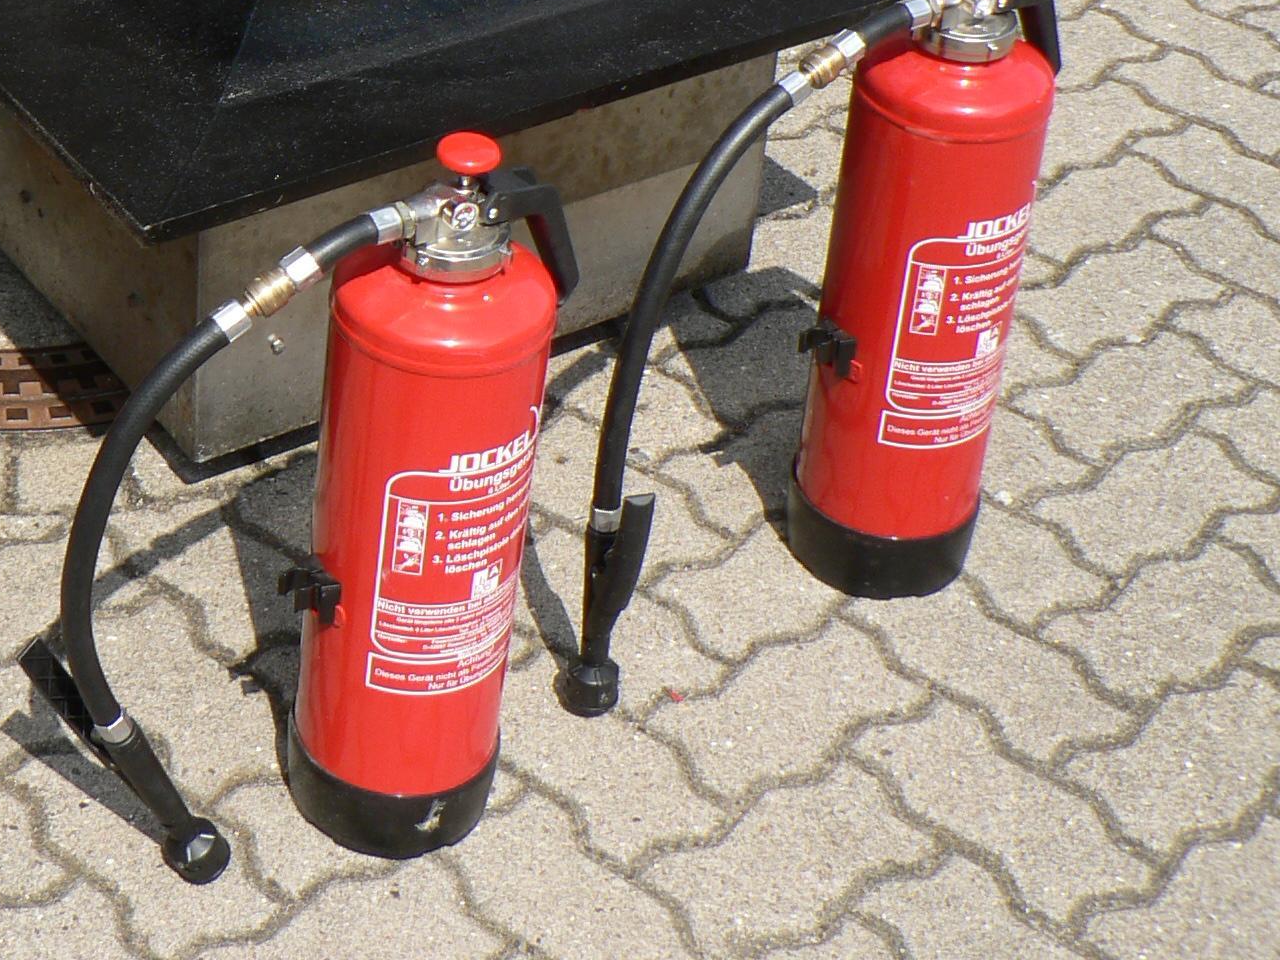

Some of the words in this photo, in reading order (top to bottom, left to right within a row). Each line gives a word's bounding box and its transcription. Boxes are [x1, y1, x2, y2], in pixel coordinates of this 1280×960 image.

[953, 276, 963, 286] 1.
[949, 293, 960, 302] 2.
[946, 315, 957, 325] 3.
[894, 360, 921, 372] Nicht
[438, 512, 448, 523] 1.
[450, 501, 505, 522] Sicherung
[434, 530, 446, 541] 2.
[448, 525, 487, 541] Kräftig
[487, 516, 504, 532] auf
[446, 532, 497, 551] schlagen
[431, 554, 444, 565] 3.
[444, 558, 488, 576] löschen
[376, 600, 407, 615] Nicht
[407, 602, 466, 617] verwenden
[374, 667, 406, 681] Dieses
[407, 673, 434, 683] Gerät
[435, 669, 457, 681] nicht
[428, 680, 445, 691] Nur
[446, 675, 459, 688] für
